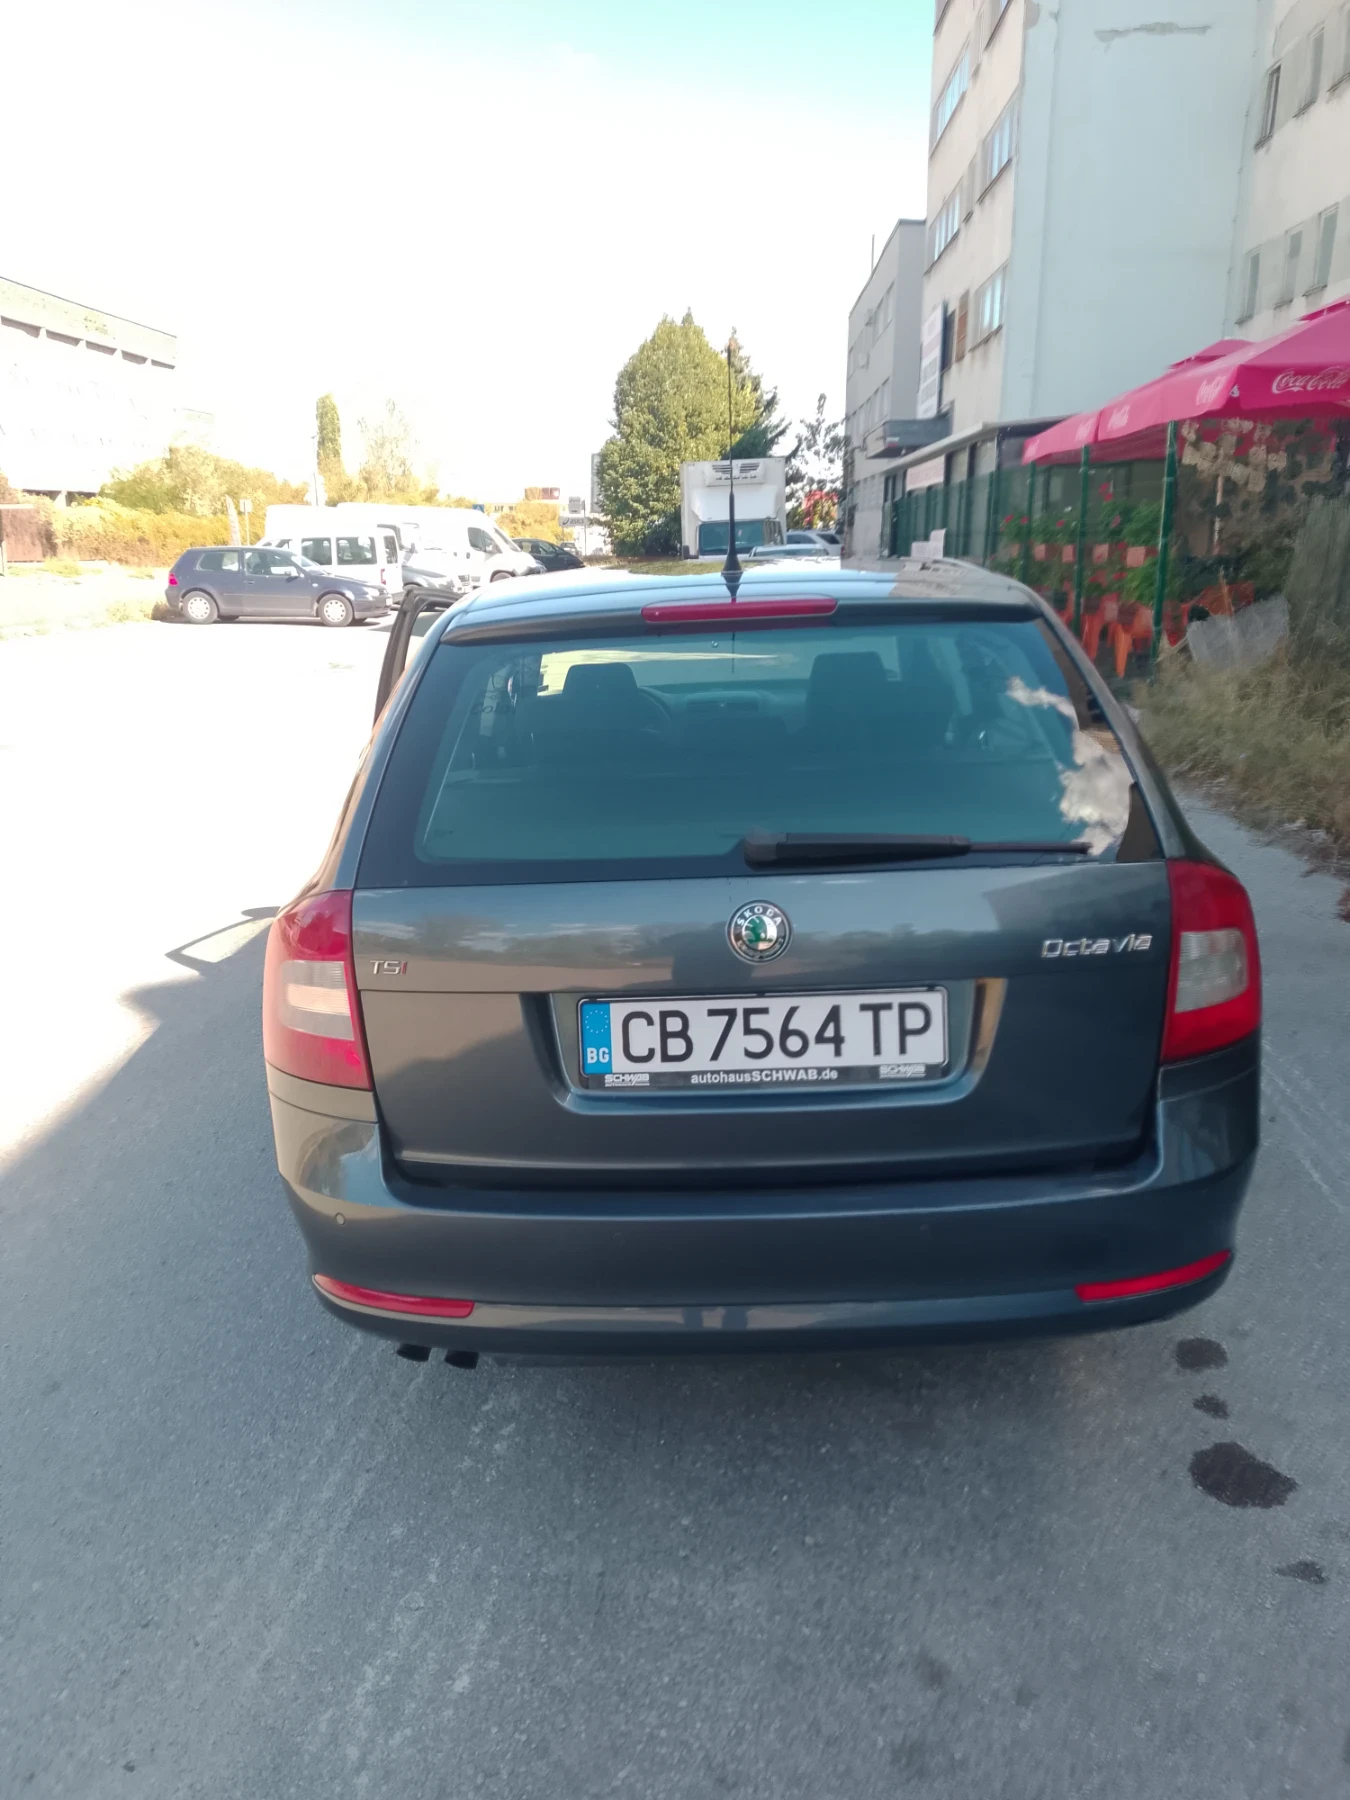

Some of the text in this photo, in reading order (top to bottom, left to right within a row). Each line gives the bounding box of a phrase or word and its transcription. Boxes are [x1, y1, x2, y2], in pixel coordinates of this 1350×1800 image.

[1041, 933, 1153, 958] Octavia
[369, 960, 408, 976] TSI
[622, 1001, 932, 1063] CB 7564 TP
[586, 1047, 610, 1064] BG
[690, 1068, 838, 1084] autohausSCHWAB.de
